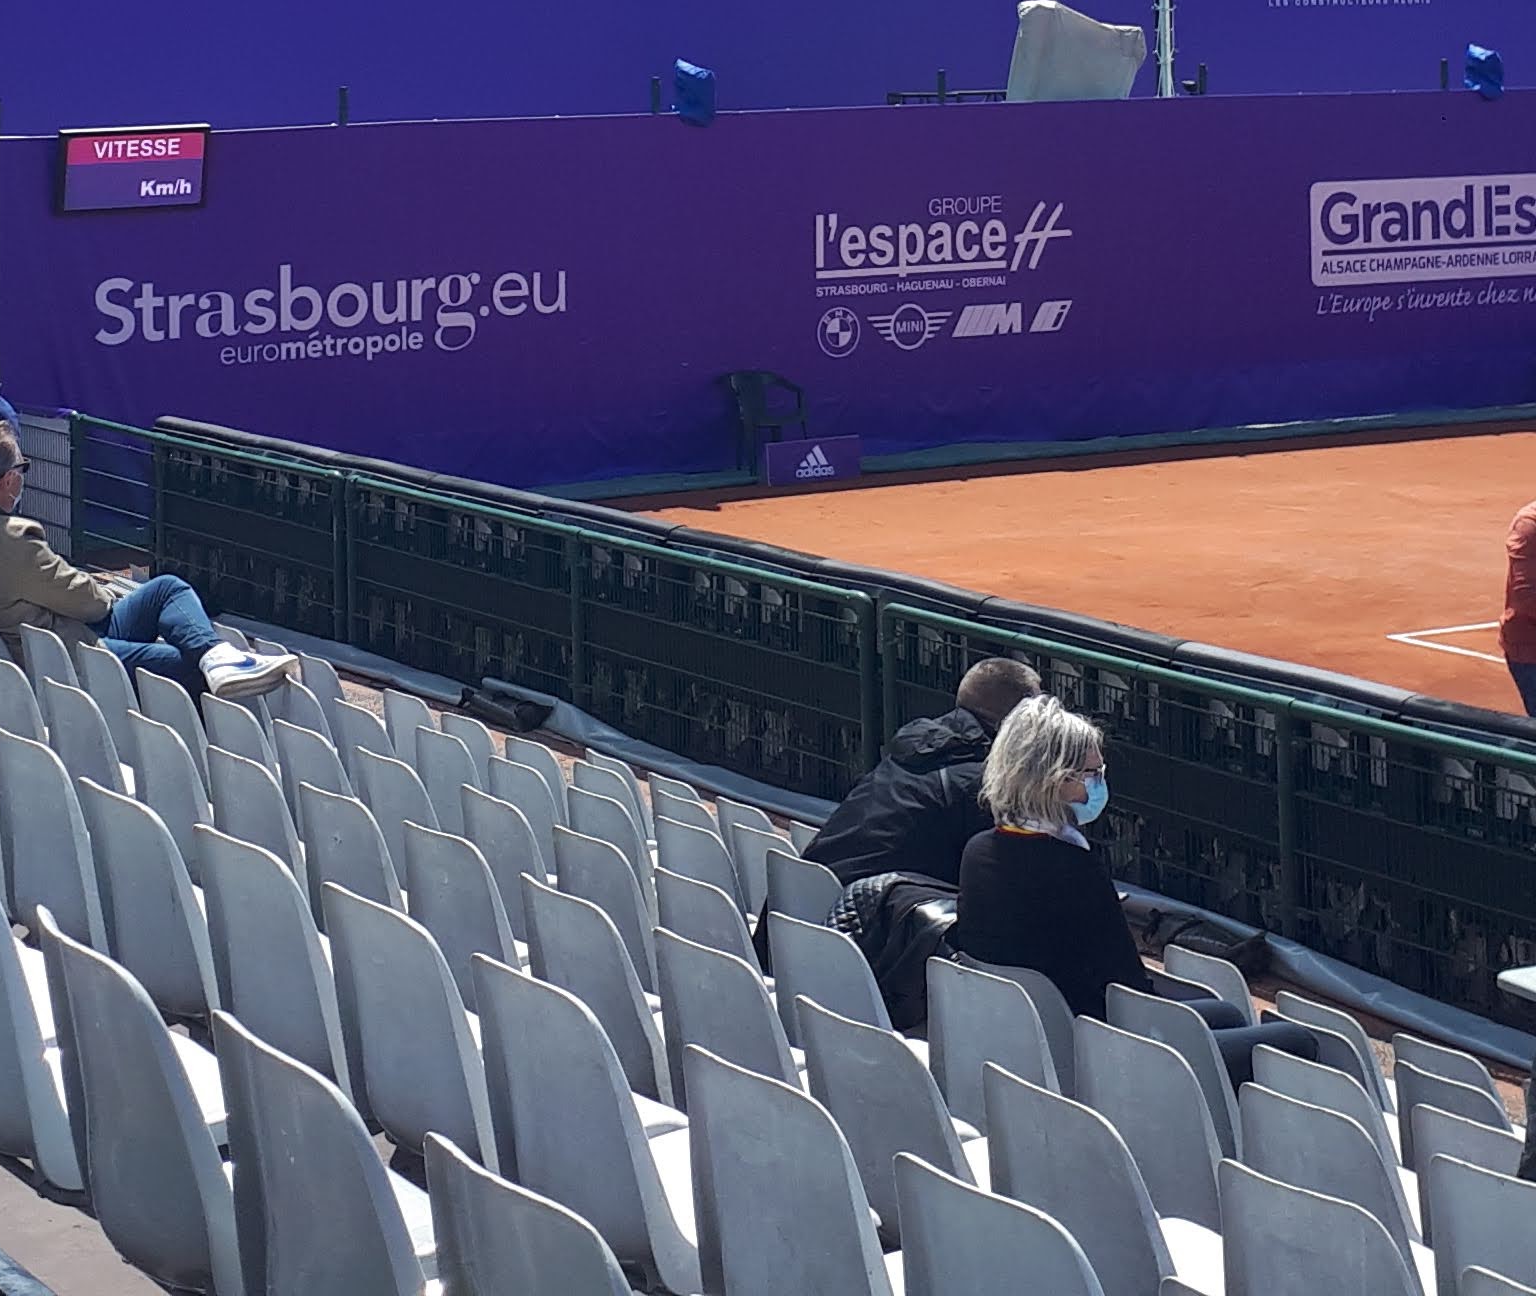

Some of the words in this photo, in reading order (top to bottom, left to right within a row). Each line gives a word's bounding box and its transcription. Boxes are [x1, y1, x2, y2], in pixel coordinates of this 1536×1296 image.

[93, 137, 181, 160] VITESSE
[139, 178, 193, 197] Km/h
[928, 195, 1002, 217] GROUPE
[815, 212, 1007, 278] l'espace
[1320, 258, 1367, 276] ALSACE
[1368, 251, 1500, 273] CHAMPAGNE-ARDENNE
[815, 282, 888, 297] STRASBOURG
[897, 278, 954, 292] HAGUENAU
[962, 275, 1007, 288] OBERNAI
[93, 264, 567, 351] Strasbourg.eu
[1316, 292, 1393, 321] L'Europe
[1476, 280, 1520, 305] chez
[895, 320, 924, 334] MINI
[219, 326, 424, 366] eurométropole
[795, 463, 835, 479] adidas
